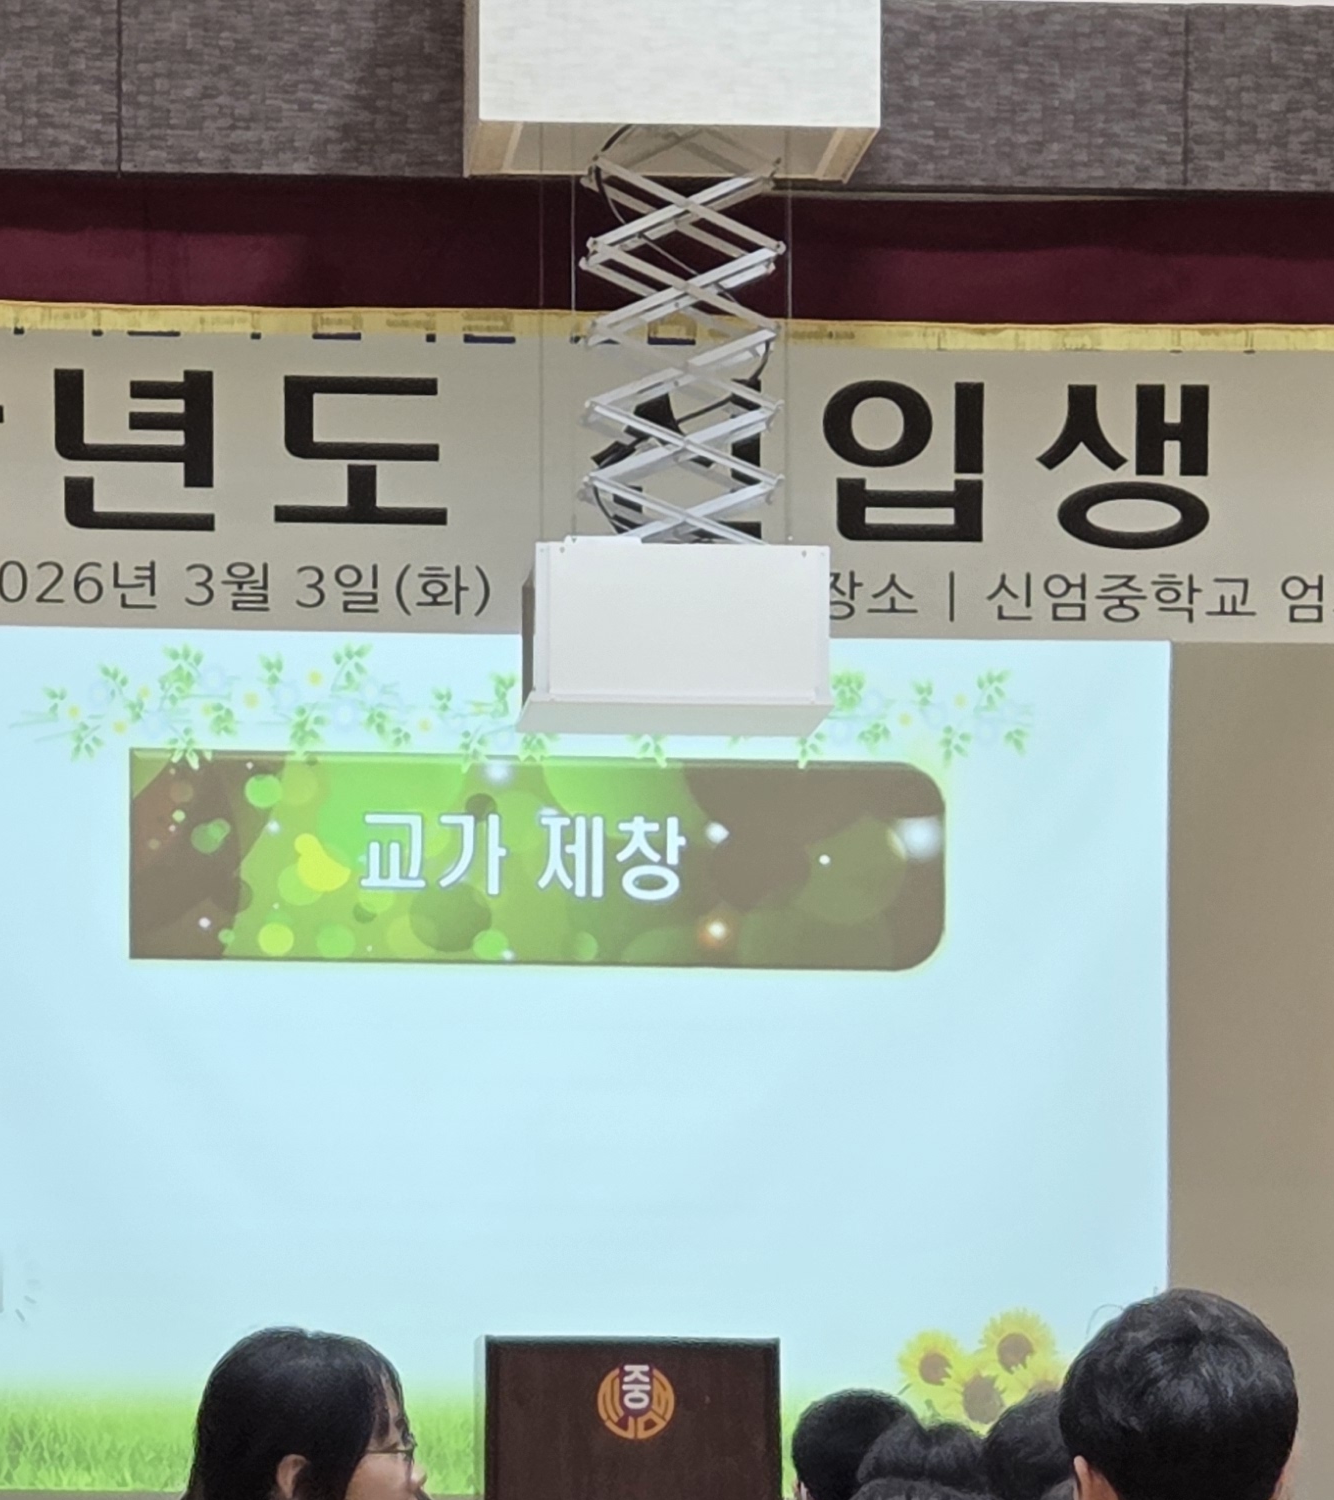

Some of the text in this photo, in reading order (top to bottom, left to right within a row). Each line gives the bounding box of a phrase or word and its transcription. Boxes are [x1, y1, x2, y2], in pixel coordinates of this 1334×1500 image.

[185, 562, 272, 614] 3월
[296, 563, 493, 619] 3일(화)
[829, 570, 919, 621] 장소
[986, 571, 1258, 626] 신엄중학교
[359, 811, 688, 902] 교가 제창
